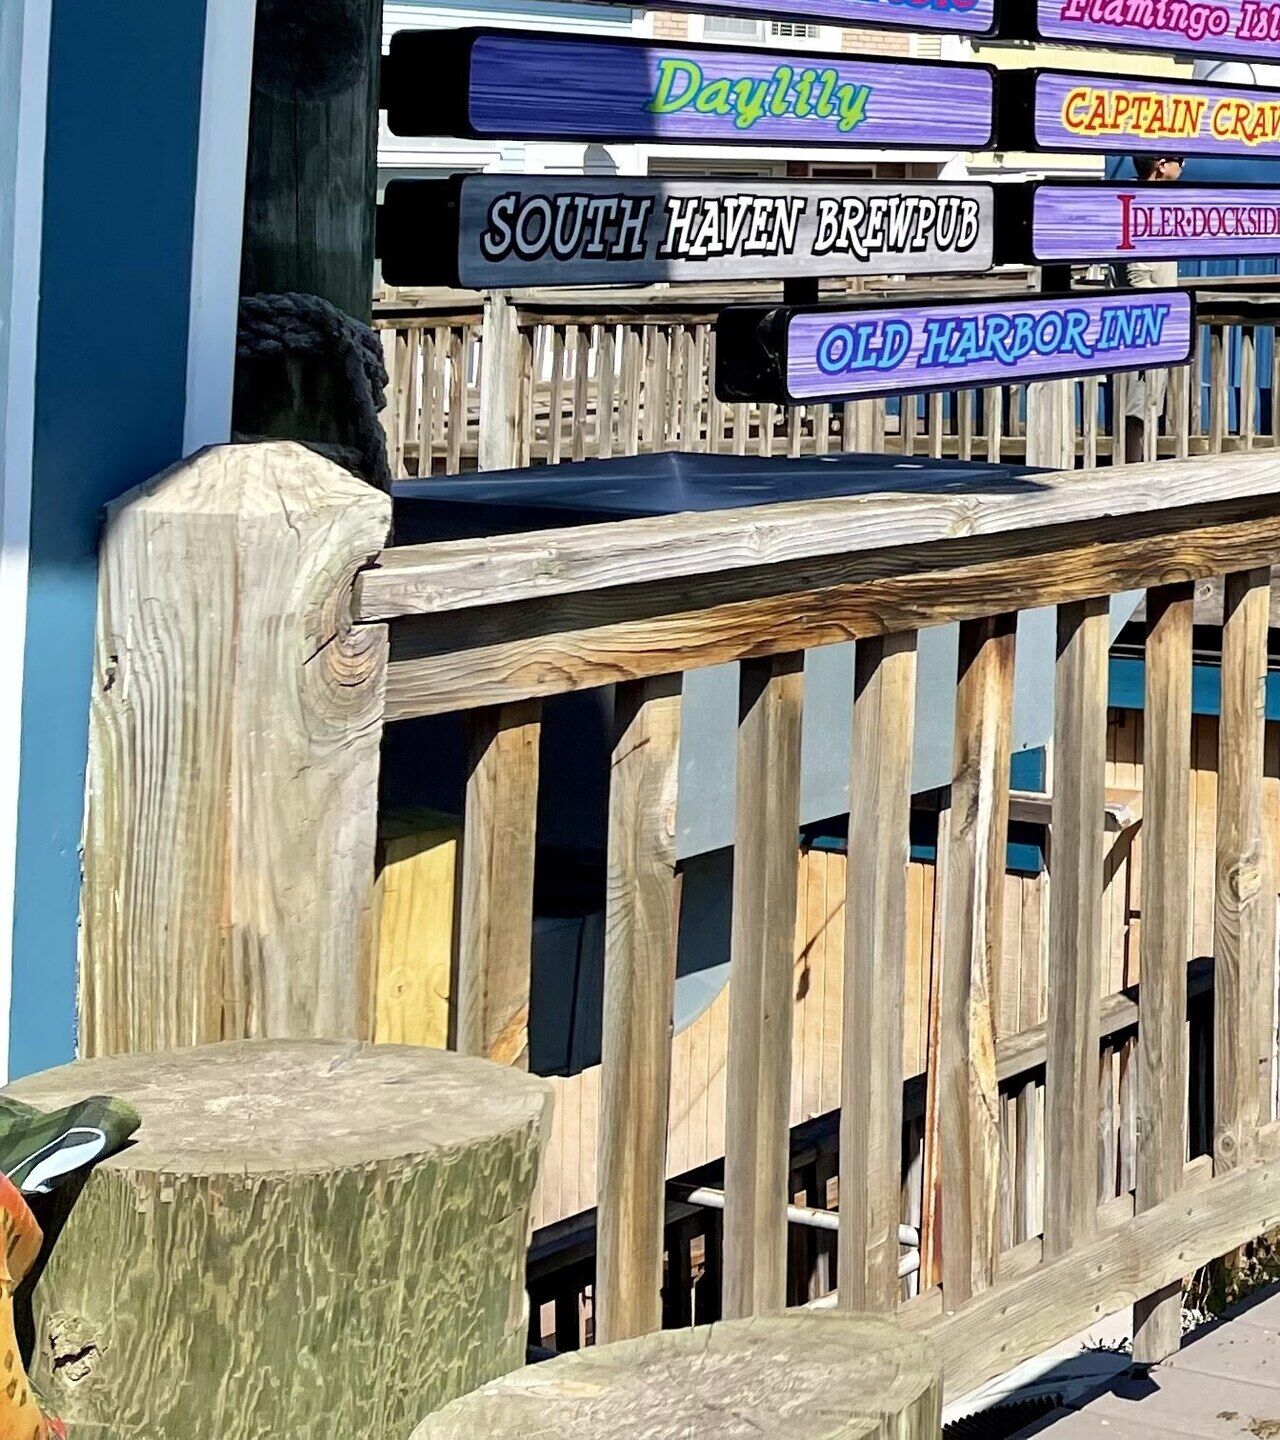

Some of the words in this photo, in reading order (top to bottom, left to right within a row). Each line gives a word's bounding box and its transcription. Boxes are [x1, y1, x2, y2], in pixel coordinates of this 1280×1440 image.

[647, 57, 871, 131] Daylily
[1062, 88, 1205, 137] CAPTAIN
[481, 191, 654, 261] SOUTH
[657, 193, 806, 258] HAVEN
[813, 196, 980, 262] BREWPUB
[1116, 194, 1186, 250] IDLER
[817, 320, 913, 375] OLD
[917, 309, 1094, 367] HARBOR
[1094, 304, 1170, 349] INN
